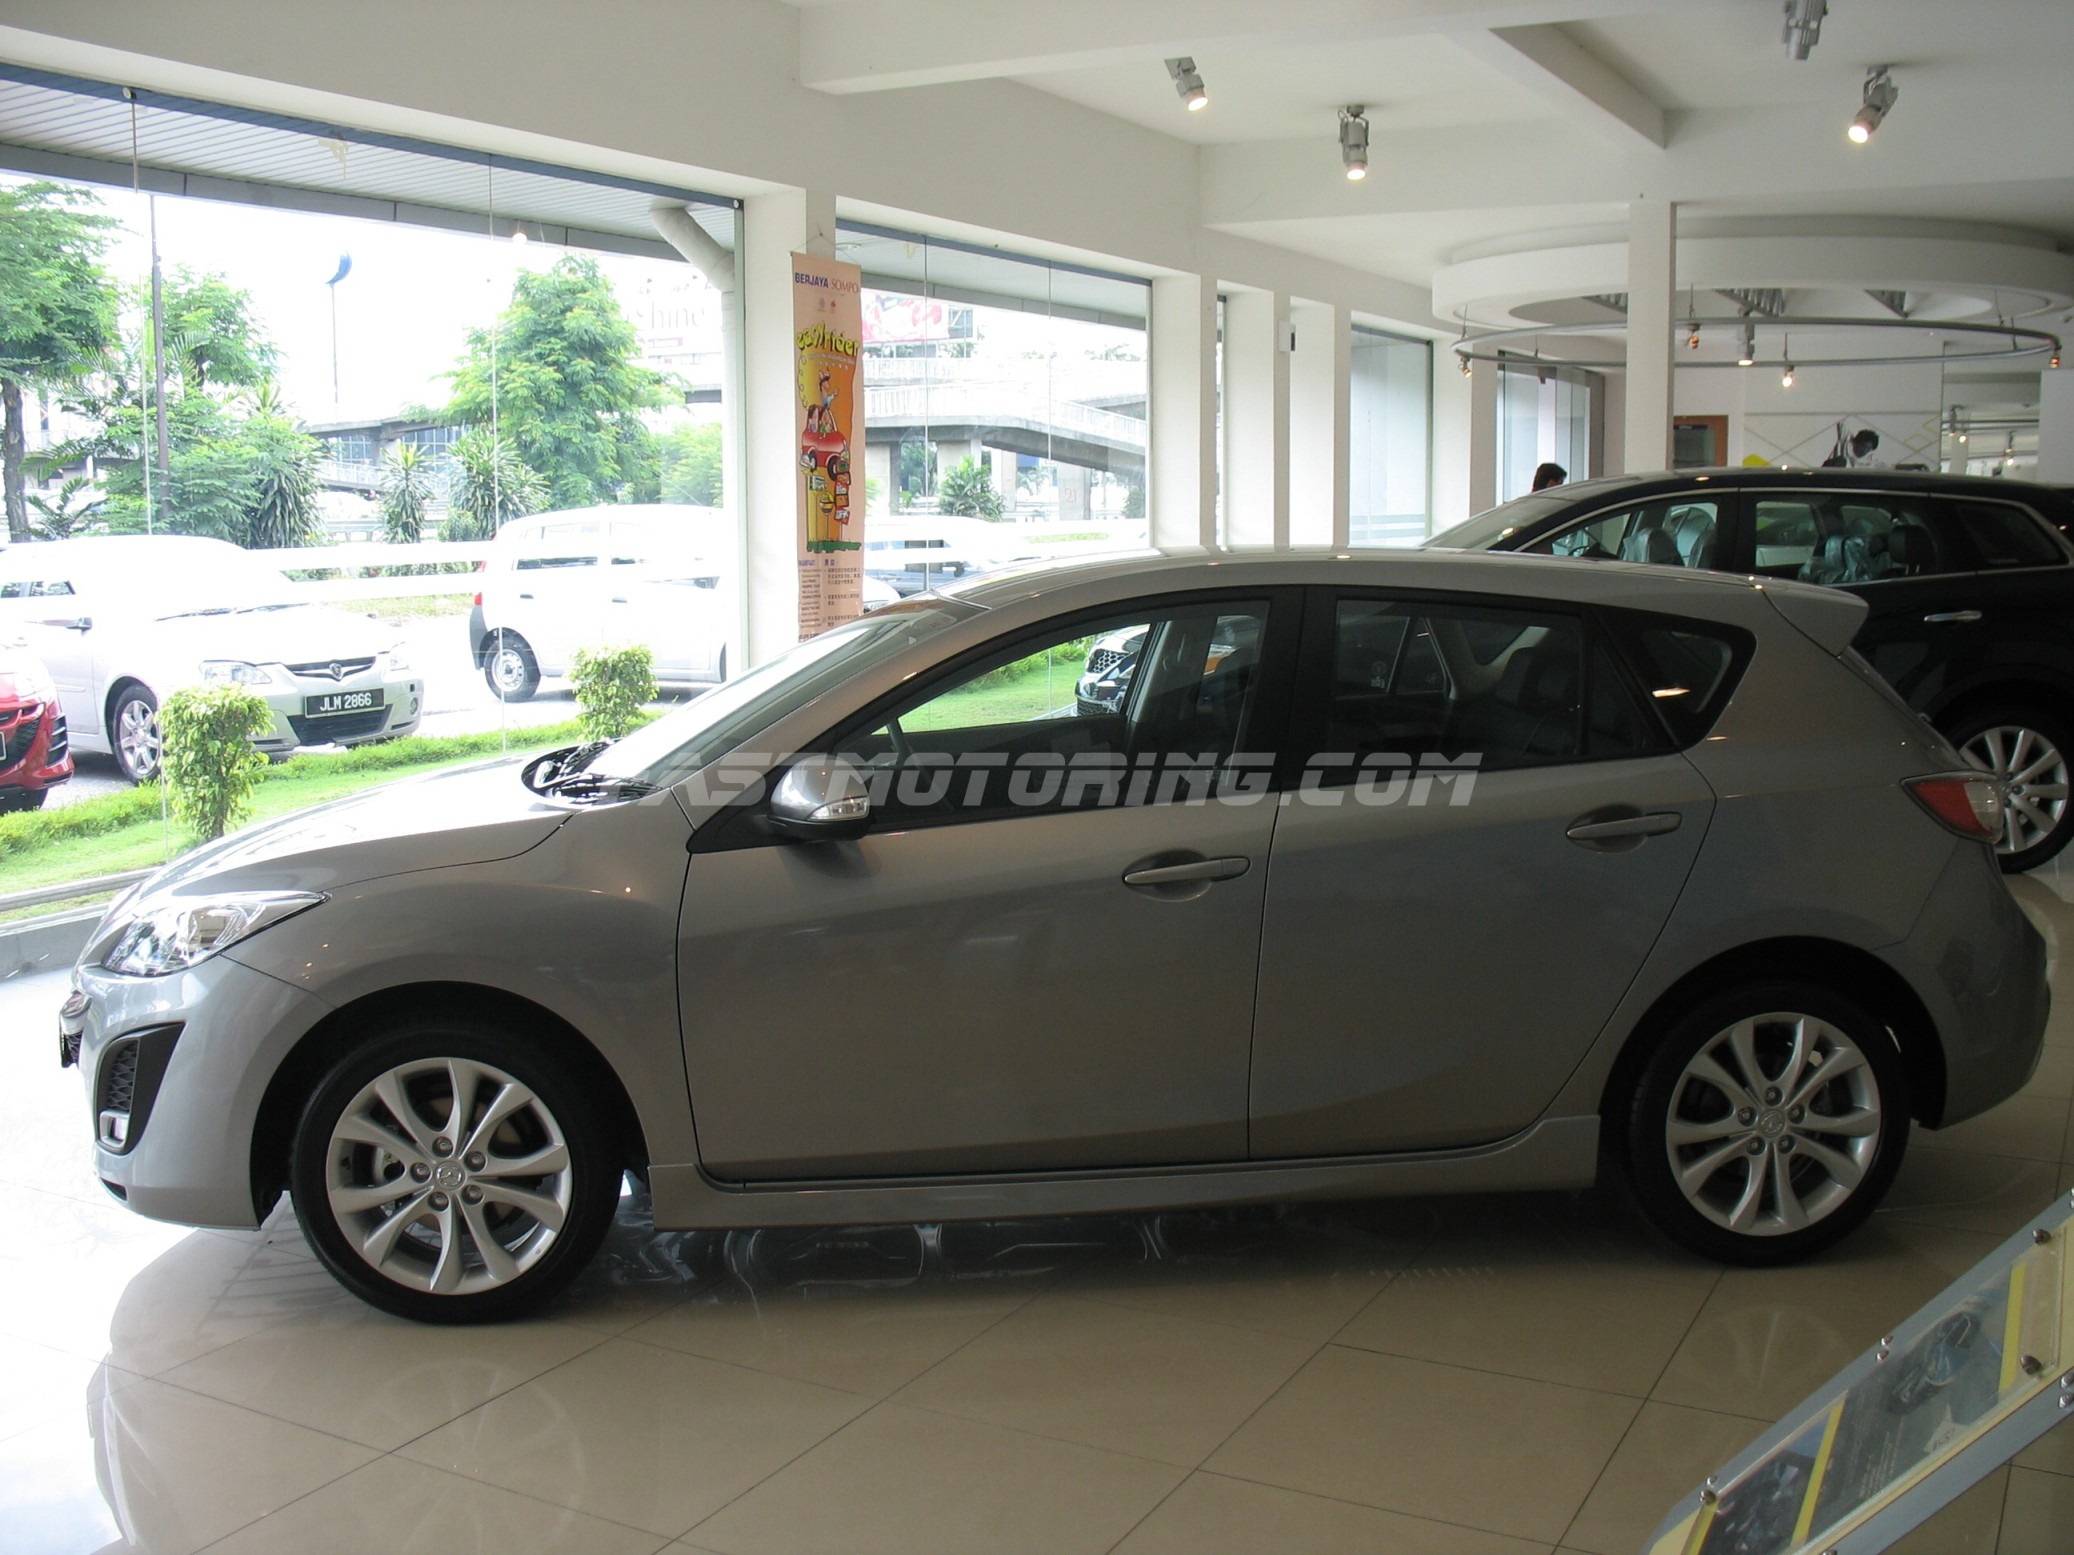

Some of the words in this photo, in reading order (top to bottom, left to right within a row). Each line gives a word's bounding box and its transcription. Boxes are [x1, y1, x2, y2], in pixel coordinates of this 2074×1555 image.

[794, 272, 829, 288] BERJAYA
[831, 278, 859, 293] SOMPO
[319, 696, 342, 711] JLM
[344, 693, 372, 709] 2866
